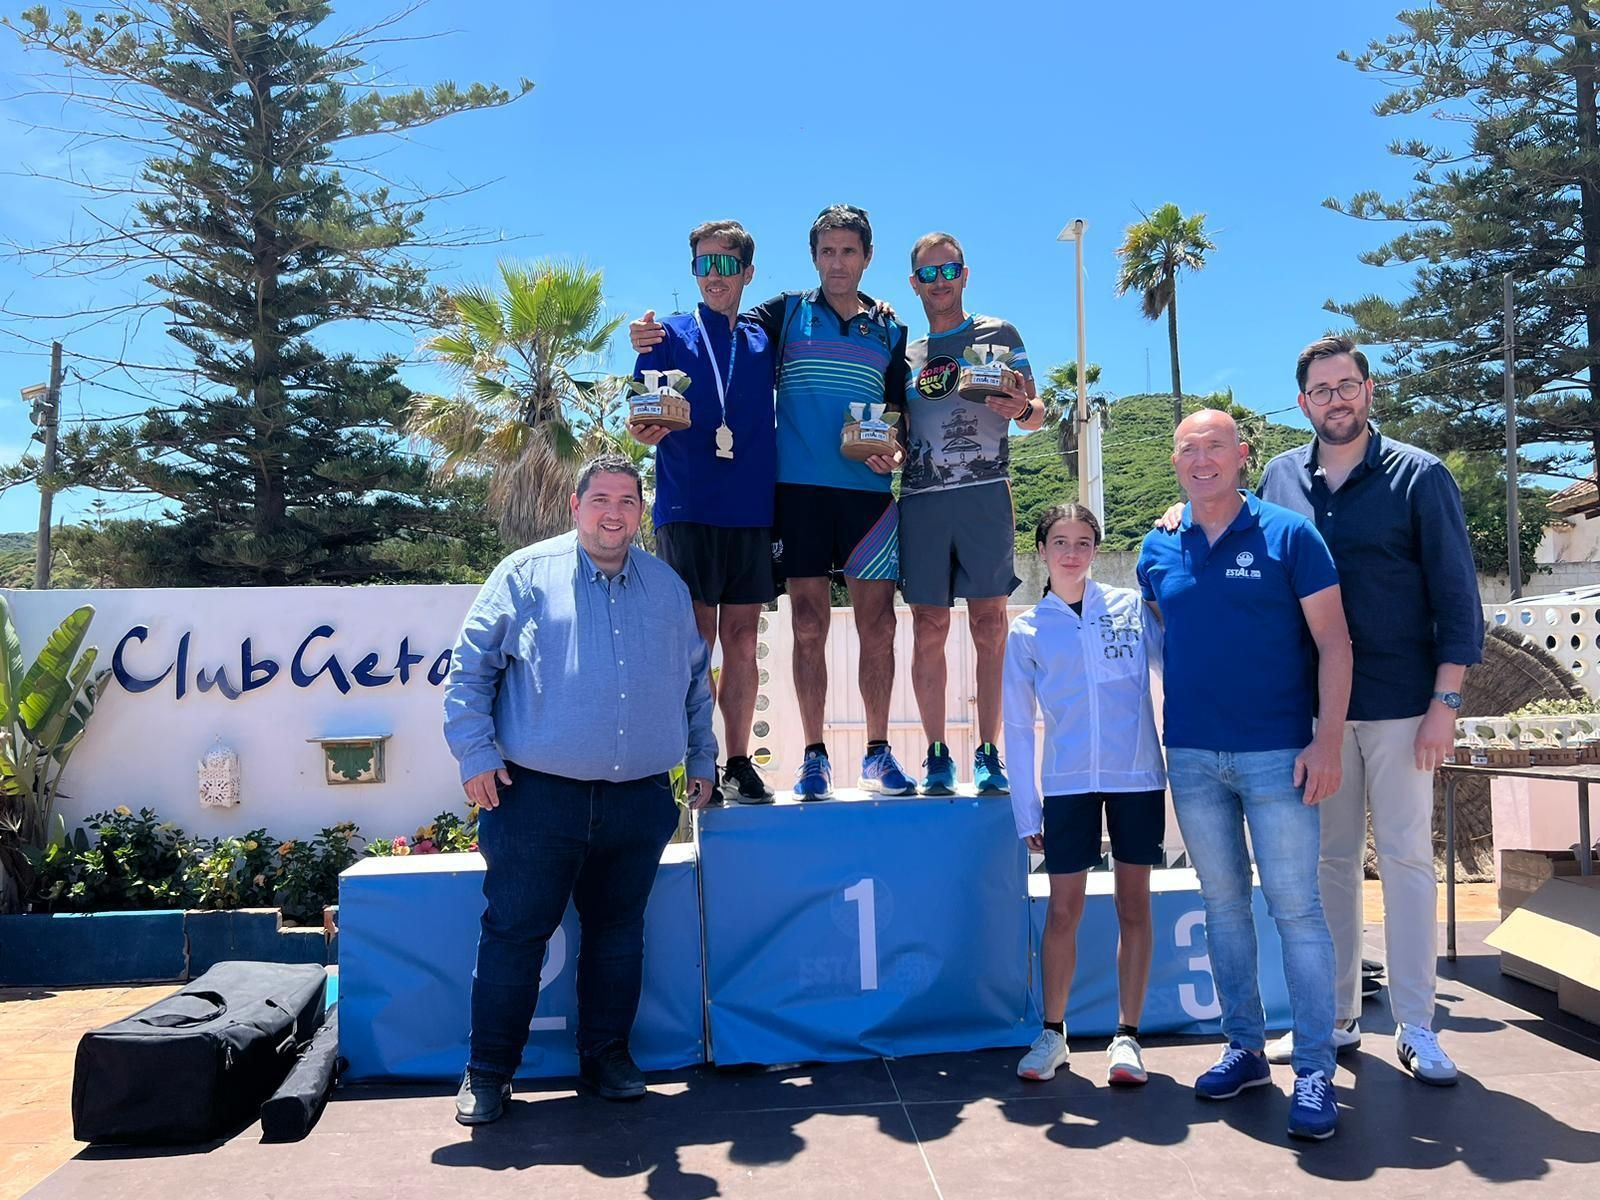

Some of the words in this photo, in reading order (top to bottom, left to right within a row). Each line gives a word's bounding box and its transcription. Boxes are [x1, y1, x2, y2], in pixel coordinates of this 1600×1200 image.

[920, 362, 957, 378] CORRO
[920, 375, 939, 386] QUE
[920, 382, 943, 394] TU
[1104, 644, 1133, 659] on
[112, 625, 280, 700] Club
[844, 878, 878, 990] 1
[1174, 910, 1223, 1020] 3
